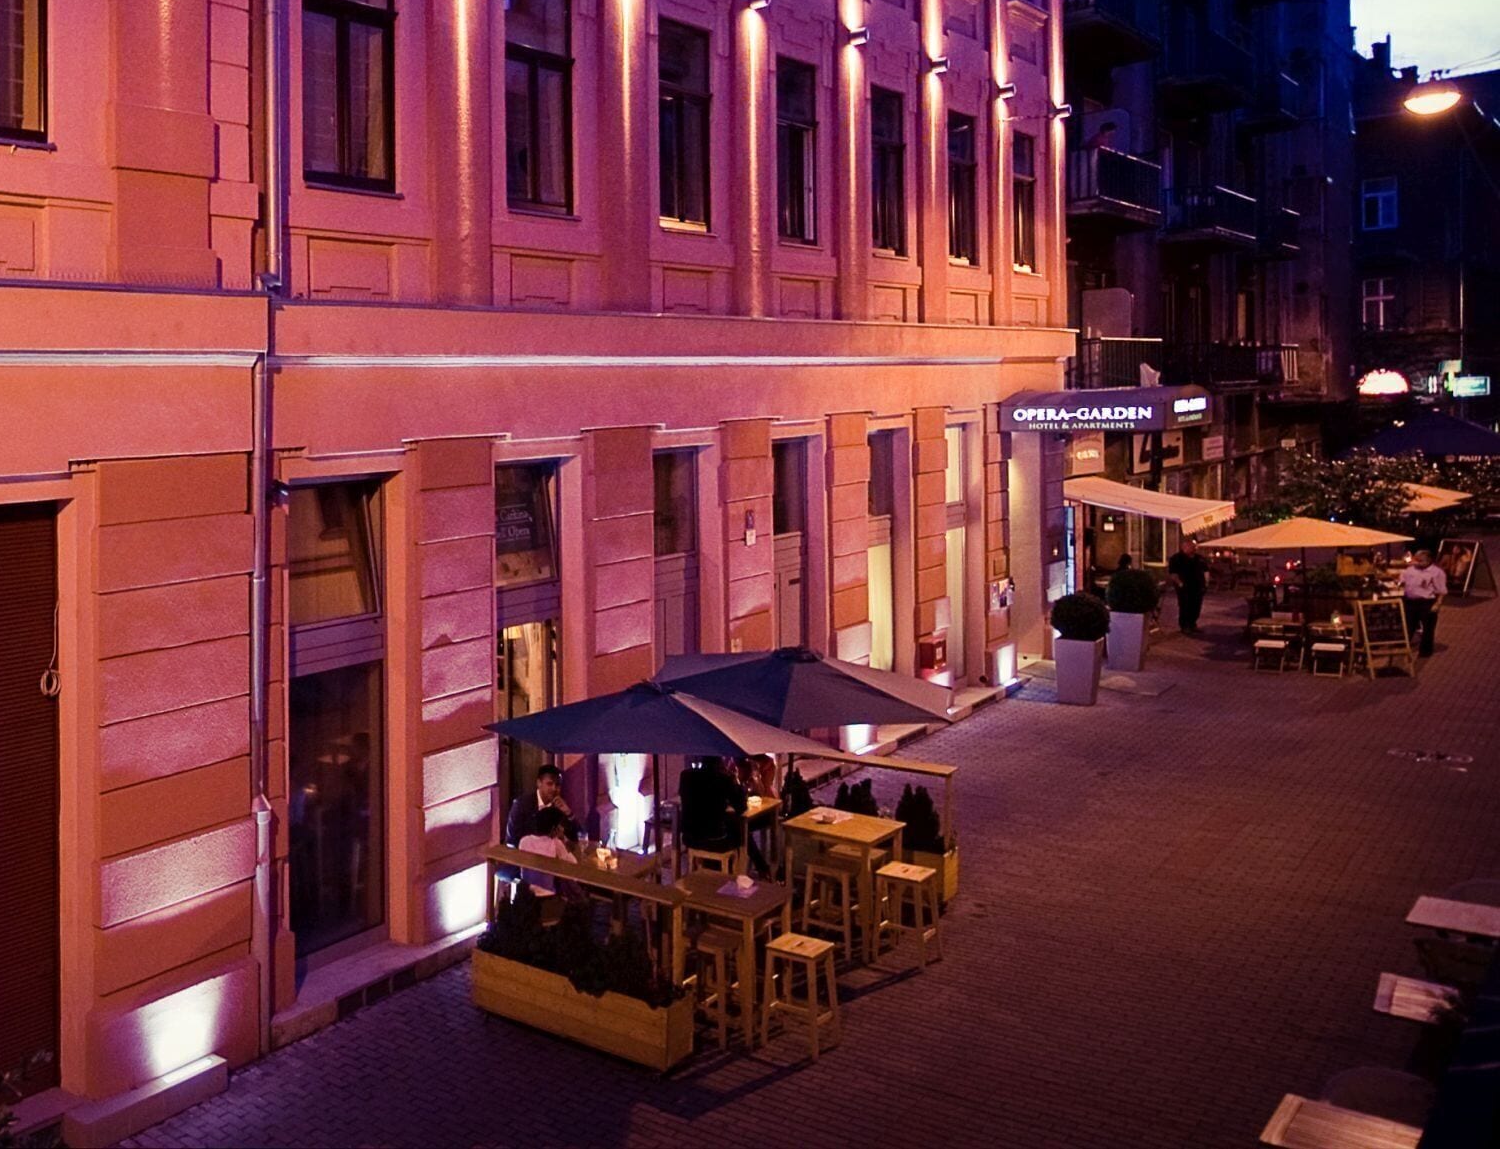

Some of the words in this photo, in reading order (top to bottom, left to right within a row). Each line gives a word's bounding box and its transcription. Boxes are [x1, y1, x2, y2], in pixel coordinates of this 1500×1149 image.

[1028, 422, 1059, 430] HOTEL
[1061, 422, 1069, 430] &
[1071, 422, 1135, 430] APARTMENTS
